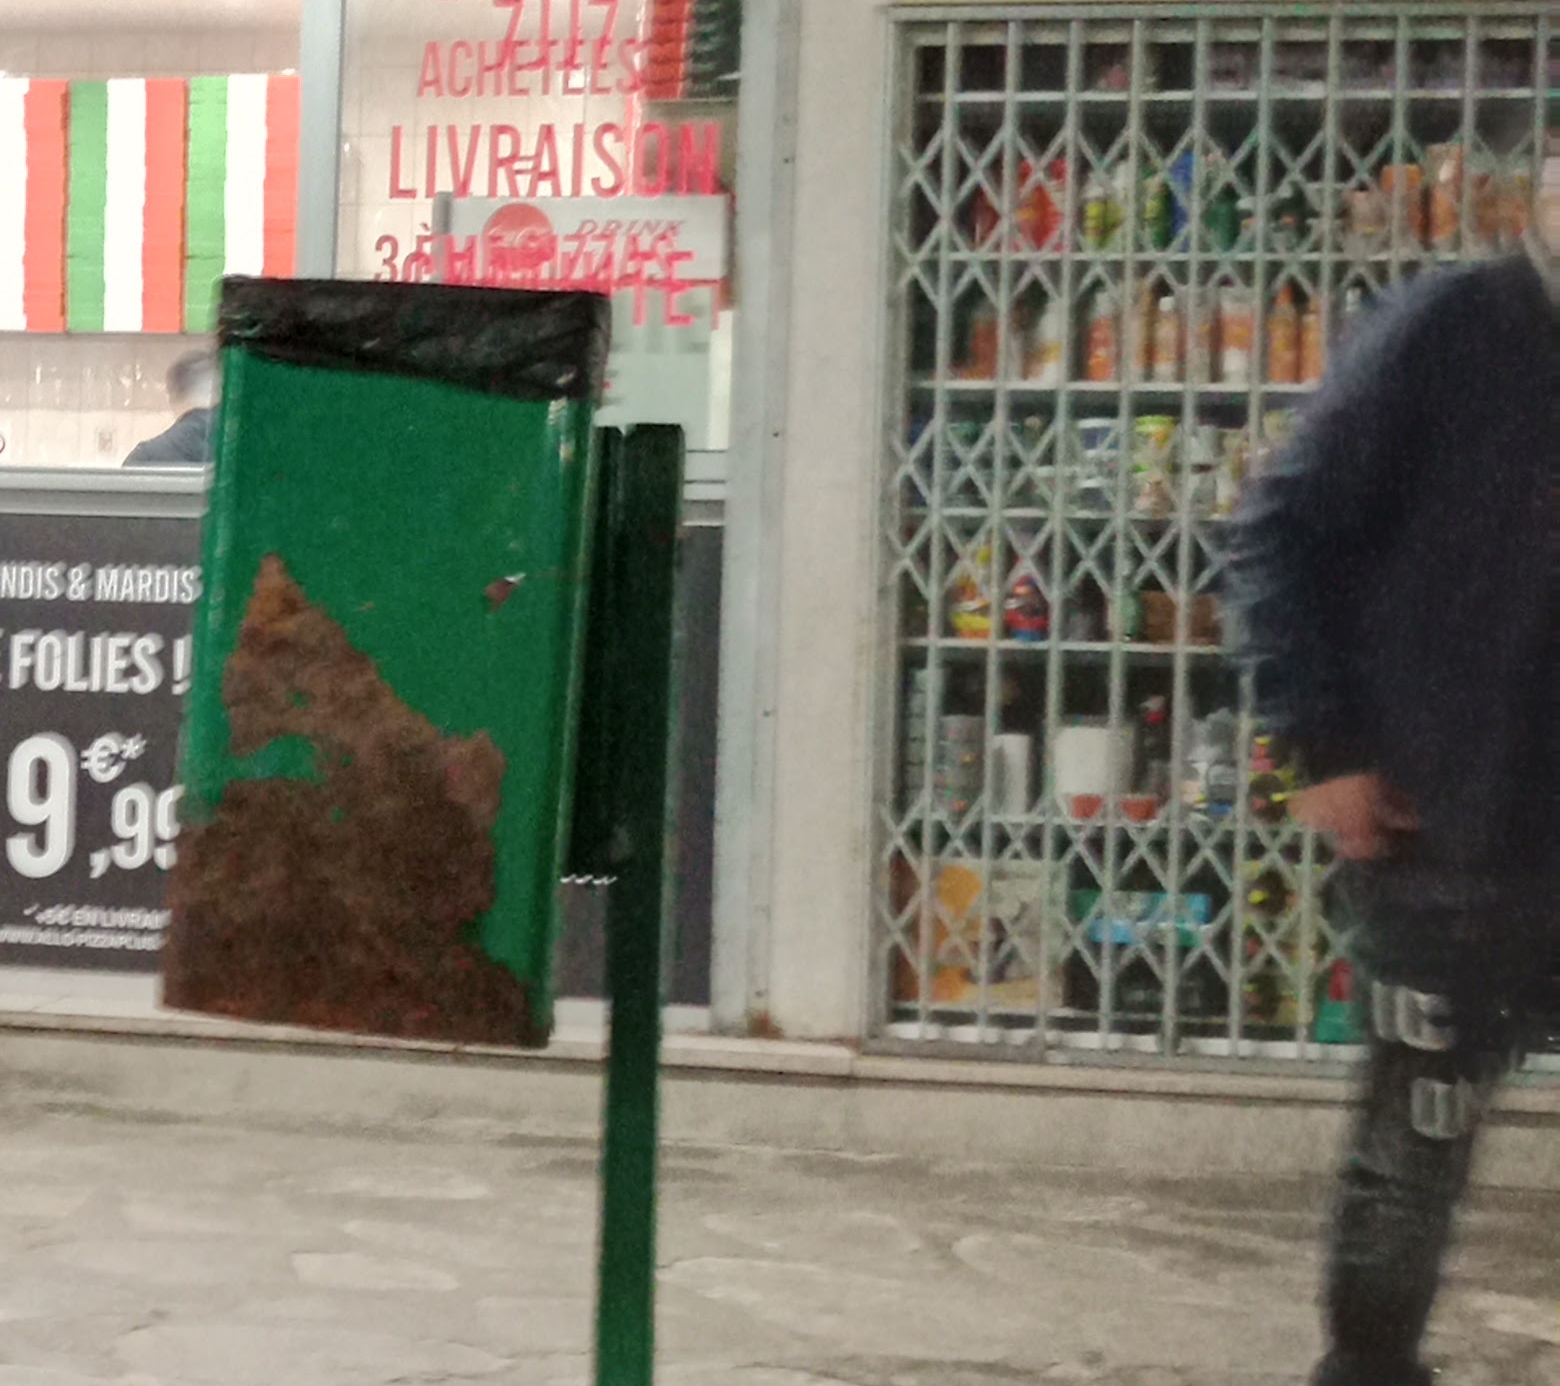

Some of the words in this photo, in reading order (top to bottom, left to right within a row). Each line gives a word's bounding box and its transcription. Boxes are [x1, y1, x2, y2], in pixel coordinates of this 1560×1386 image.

[389, 123, 723, 200] LIVRAISON
[68, 562, 92, 601] &
[94, 564, 202, 604] MARDIS
[9, 629, 164, 695] FOLIES
[6, 731, 78, 879] 9
